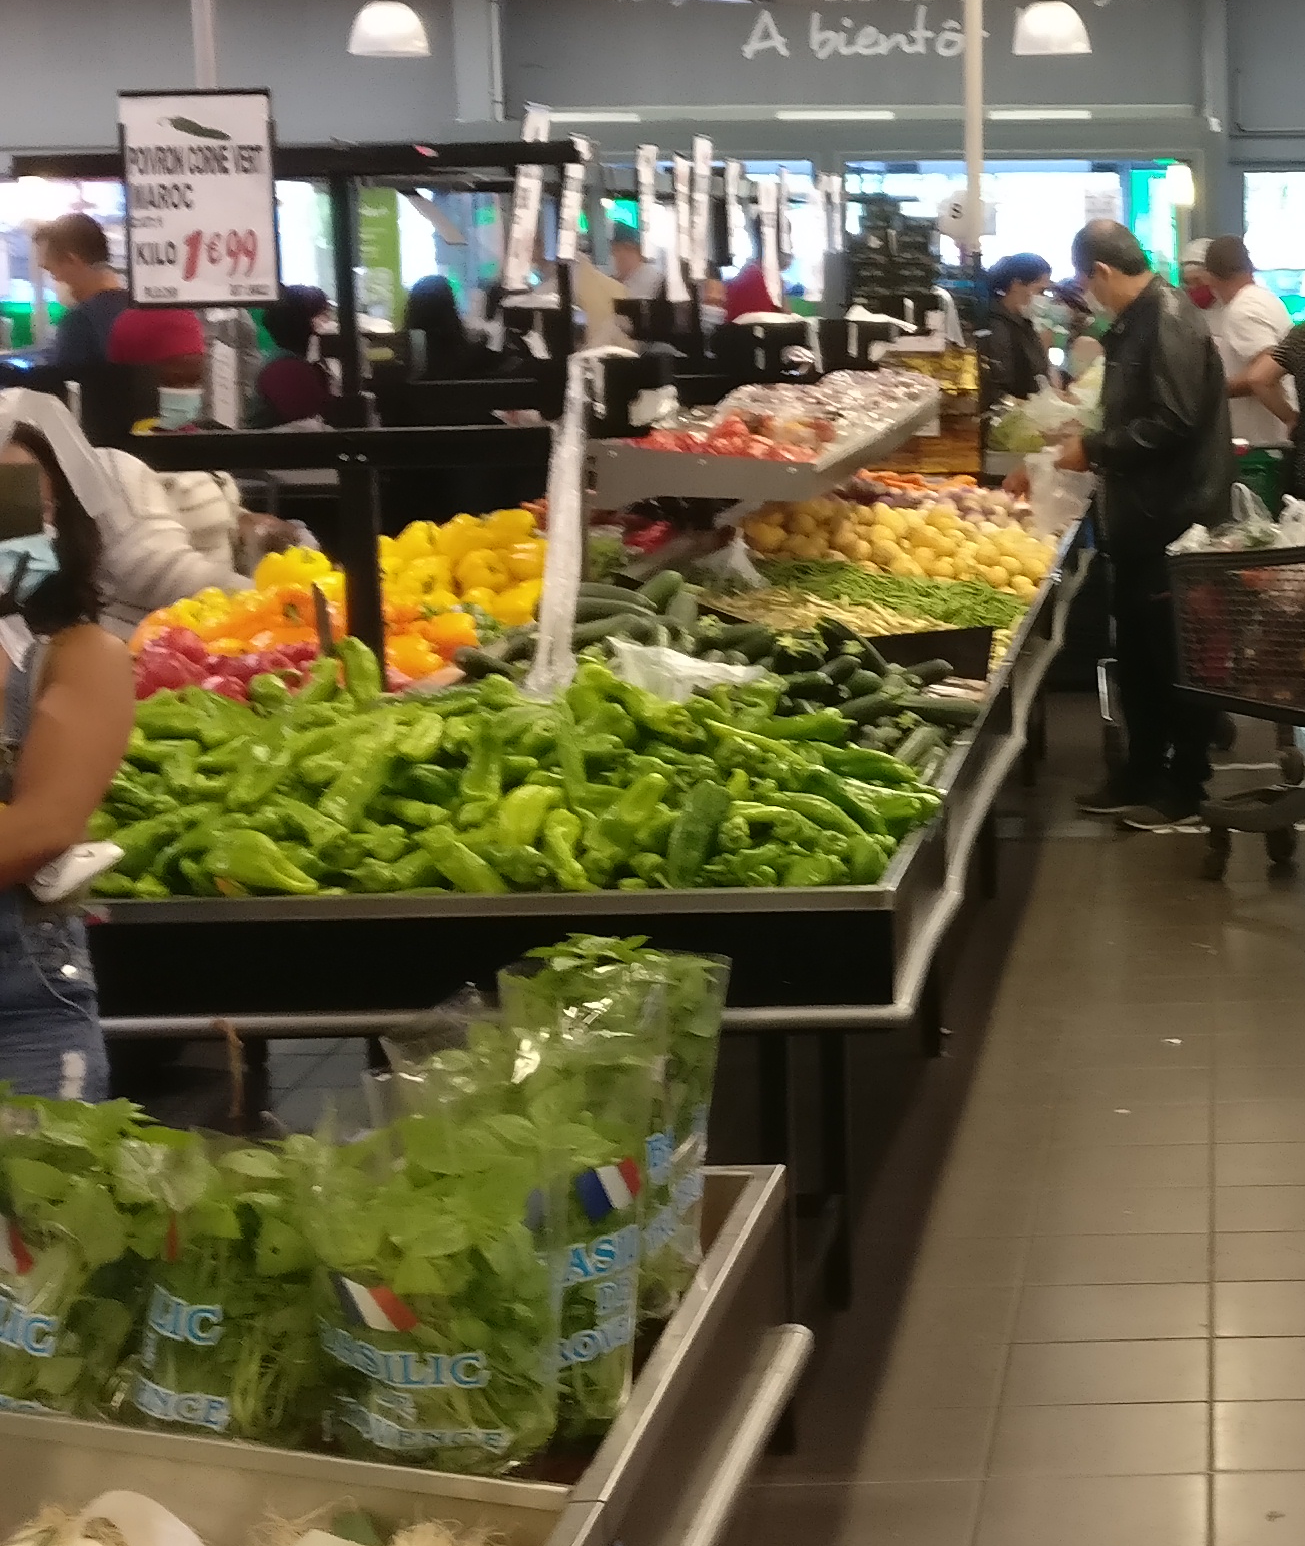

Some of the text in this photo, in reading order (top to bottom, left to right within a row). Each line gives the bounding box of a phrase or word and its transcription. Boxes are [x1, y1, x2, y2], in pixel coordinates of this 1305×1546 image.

[740, 5, 991, 59] A bientô
[128, 182, 195, 210] MAROC
[135, 239, 178, 266] KILO
